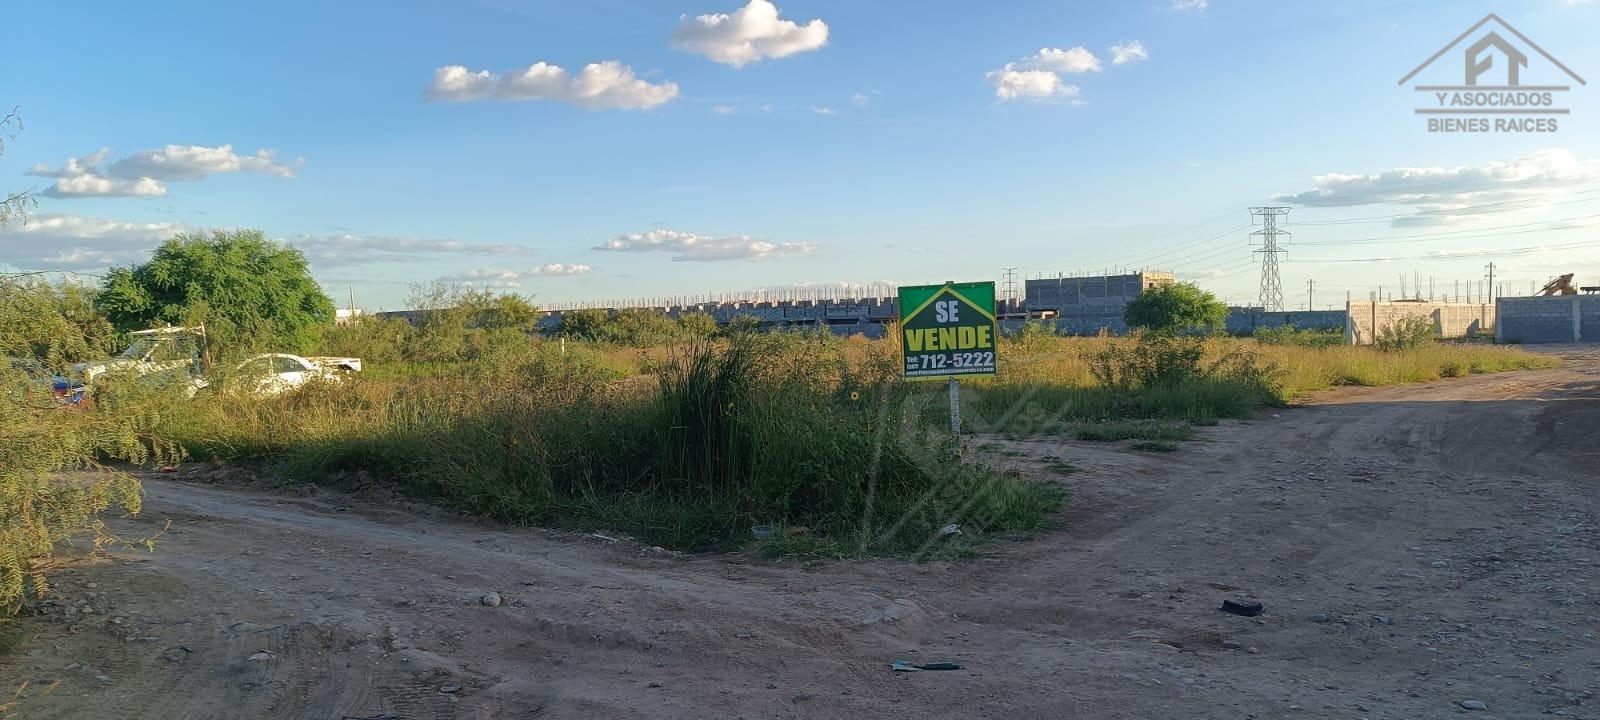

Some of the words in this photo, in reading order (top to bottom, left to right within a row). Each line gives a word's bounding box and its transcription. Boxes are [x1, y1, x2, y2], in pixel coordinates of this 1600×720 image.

[936, 301, 959, 322] SE
[905, 326, 992, 351] VENDE
[920, 351, 994, 369] 712-5222
